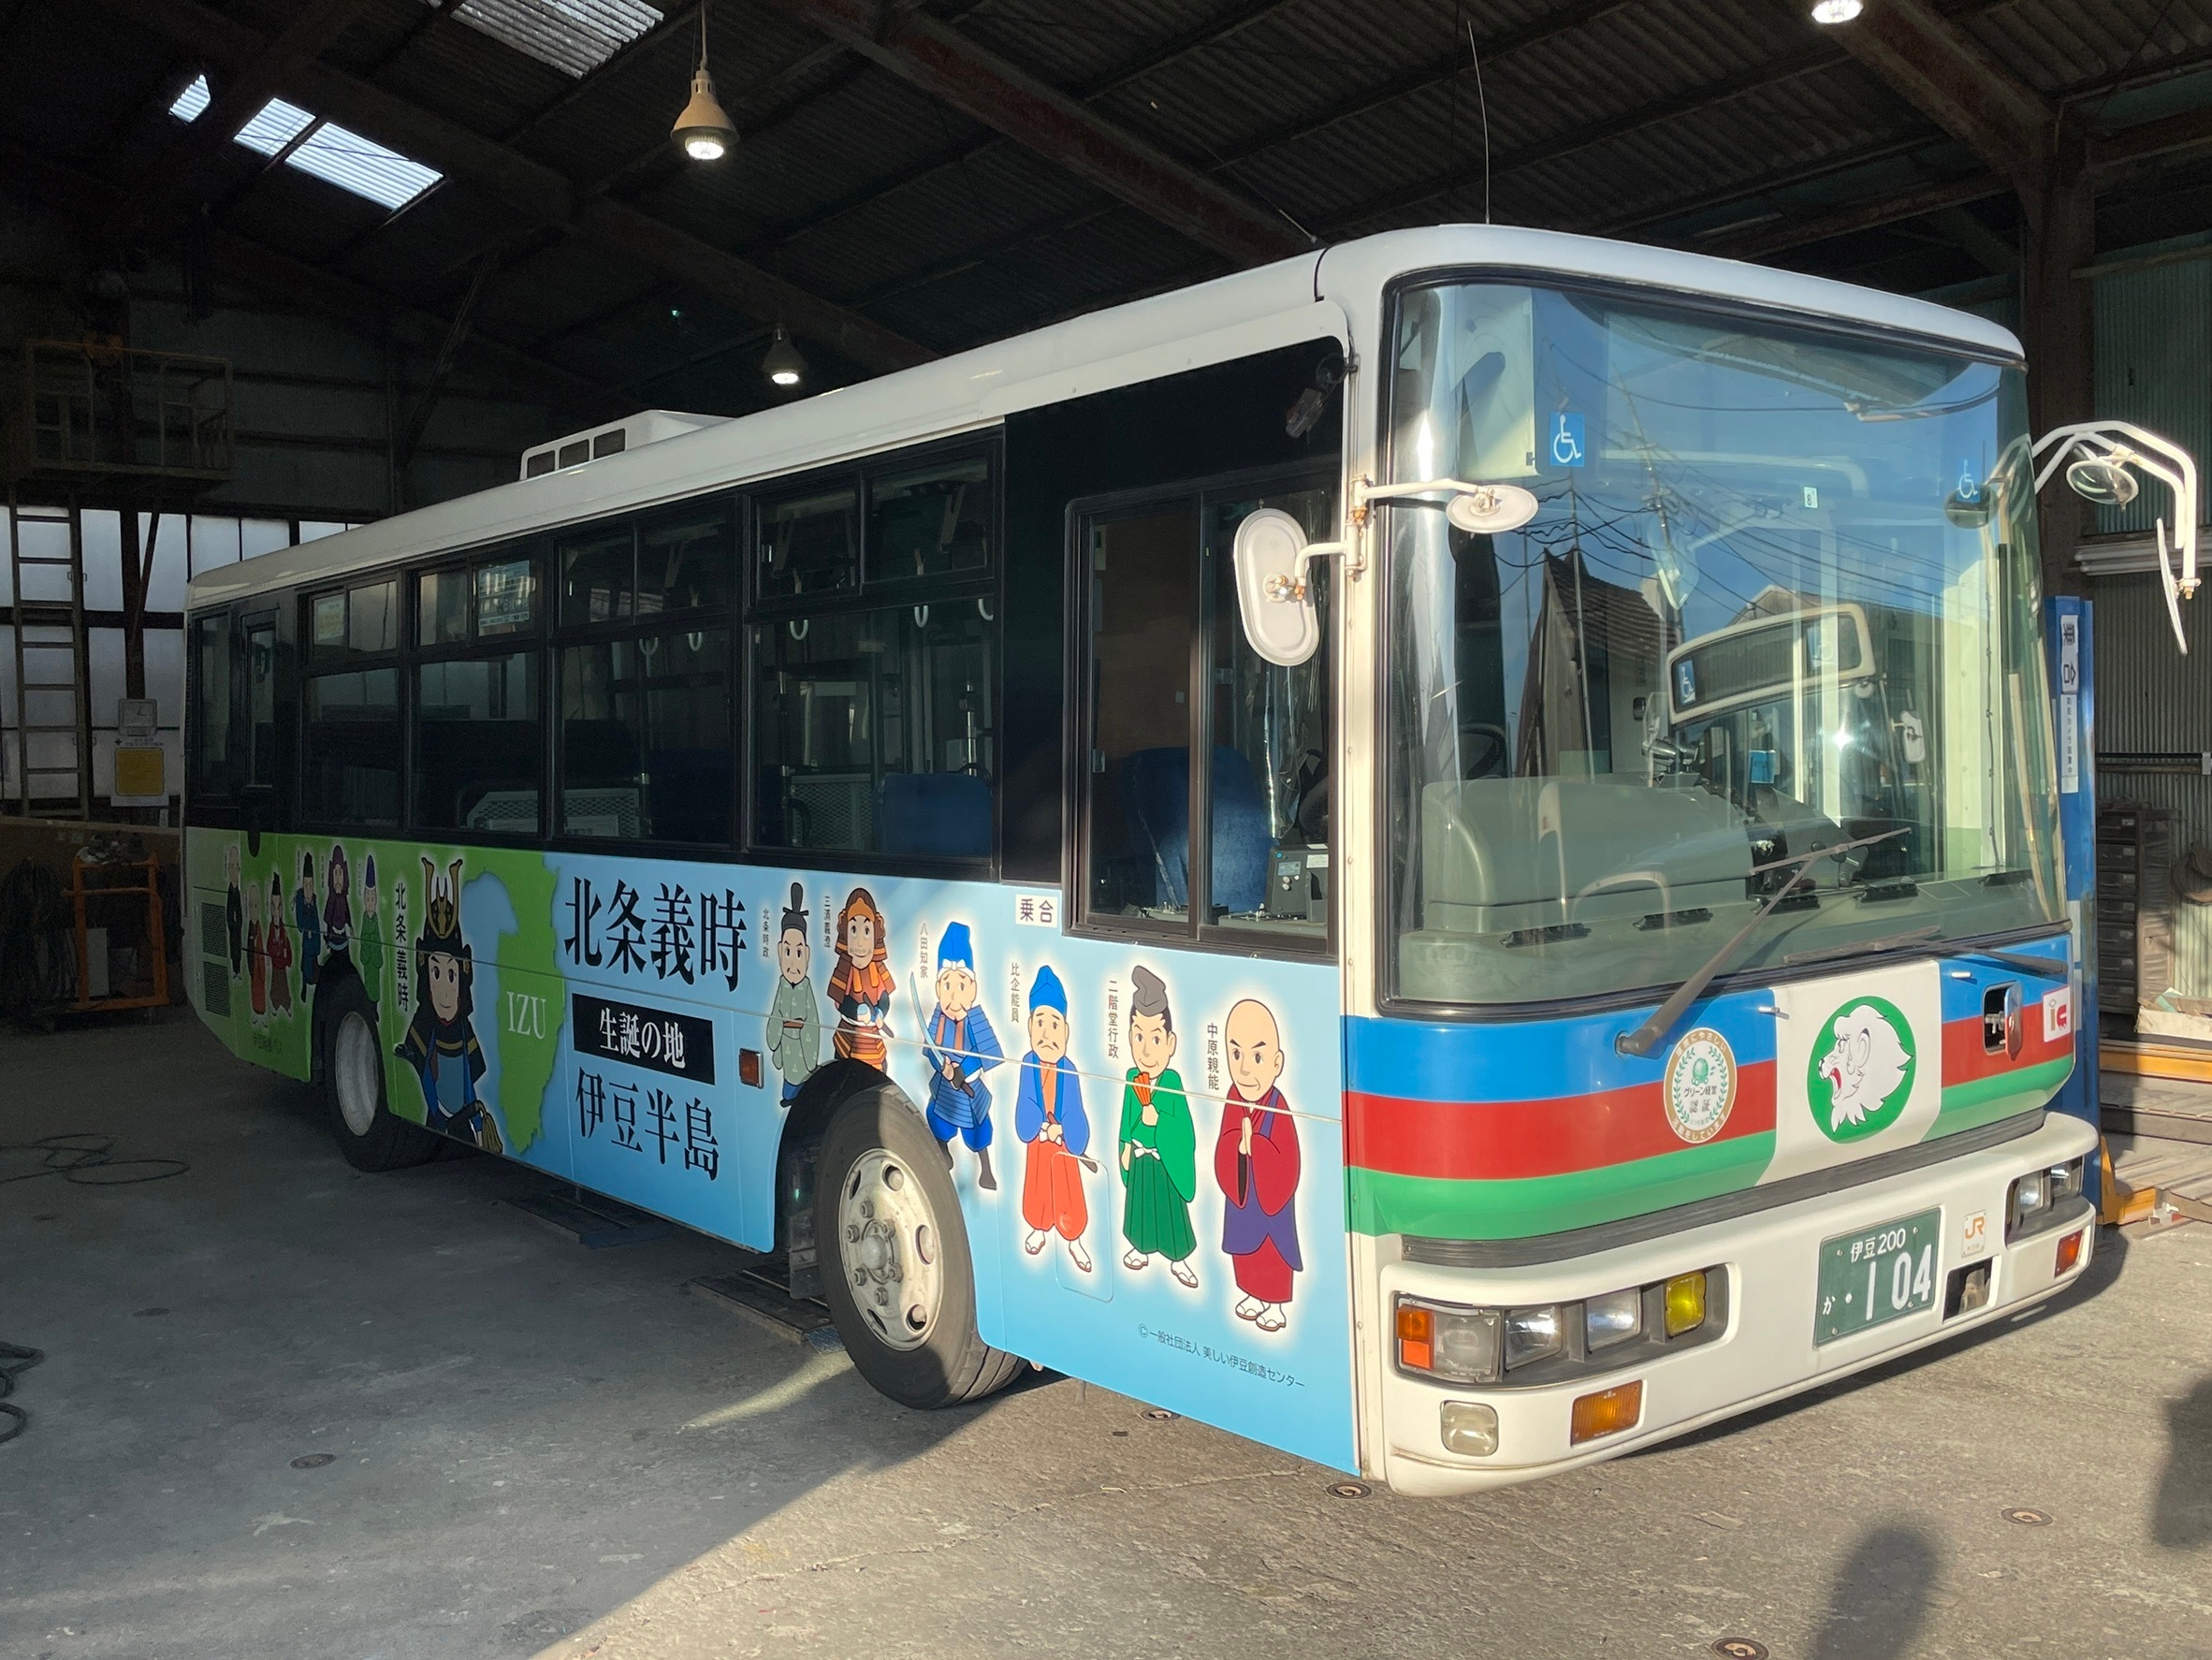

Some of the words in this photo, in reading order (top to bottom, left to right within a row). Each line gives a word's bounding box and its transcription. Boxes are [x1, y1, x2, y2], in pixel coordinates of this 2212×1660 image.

[564, 876, 747, 992] 北条義時
[1020, 898, 1054, 924] 乗合
[396, 882, 408, 1012] 北条義時
[920, 923, 928, 979] 八田知家
[506, 991, 546, 1040] IZU
[1011, 962, 1020, 1024] 比企能員
[1108, 981, 1118, 1059] 二階堂行政
[599, 1007, 686, 1069] 生誕の地
[1207, 1023, 1219, 1091] 中原親能
[1684, 1085, 1717, 1098] グリーン経営
[575, 1066, 719, 1181] 伊豆半島
[1851, 1228, 1906, 1263] 伊豆200
[1965, 1216, 1985, 1239] JR
[1823, 1296, 1836, 1316] か
